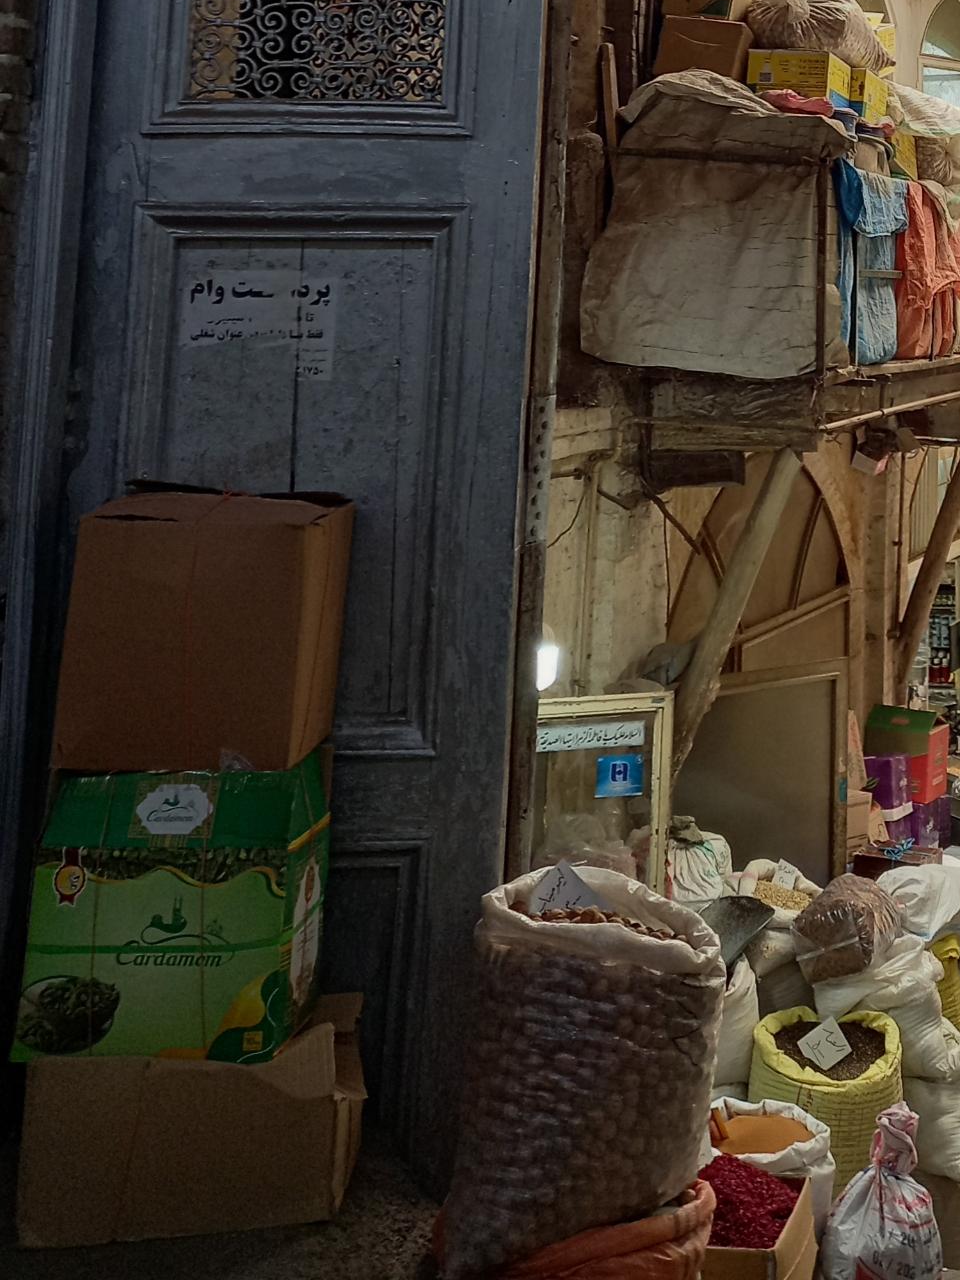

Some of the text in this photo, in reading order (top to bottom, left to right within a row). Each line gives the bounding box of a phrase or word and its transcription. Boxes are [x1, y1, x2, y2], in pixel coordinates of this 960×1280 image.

[190, 279, 226, 305] وام
[218, 329, 243, 341] عنوان
[116, 939, 222, 968] Cardamom
